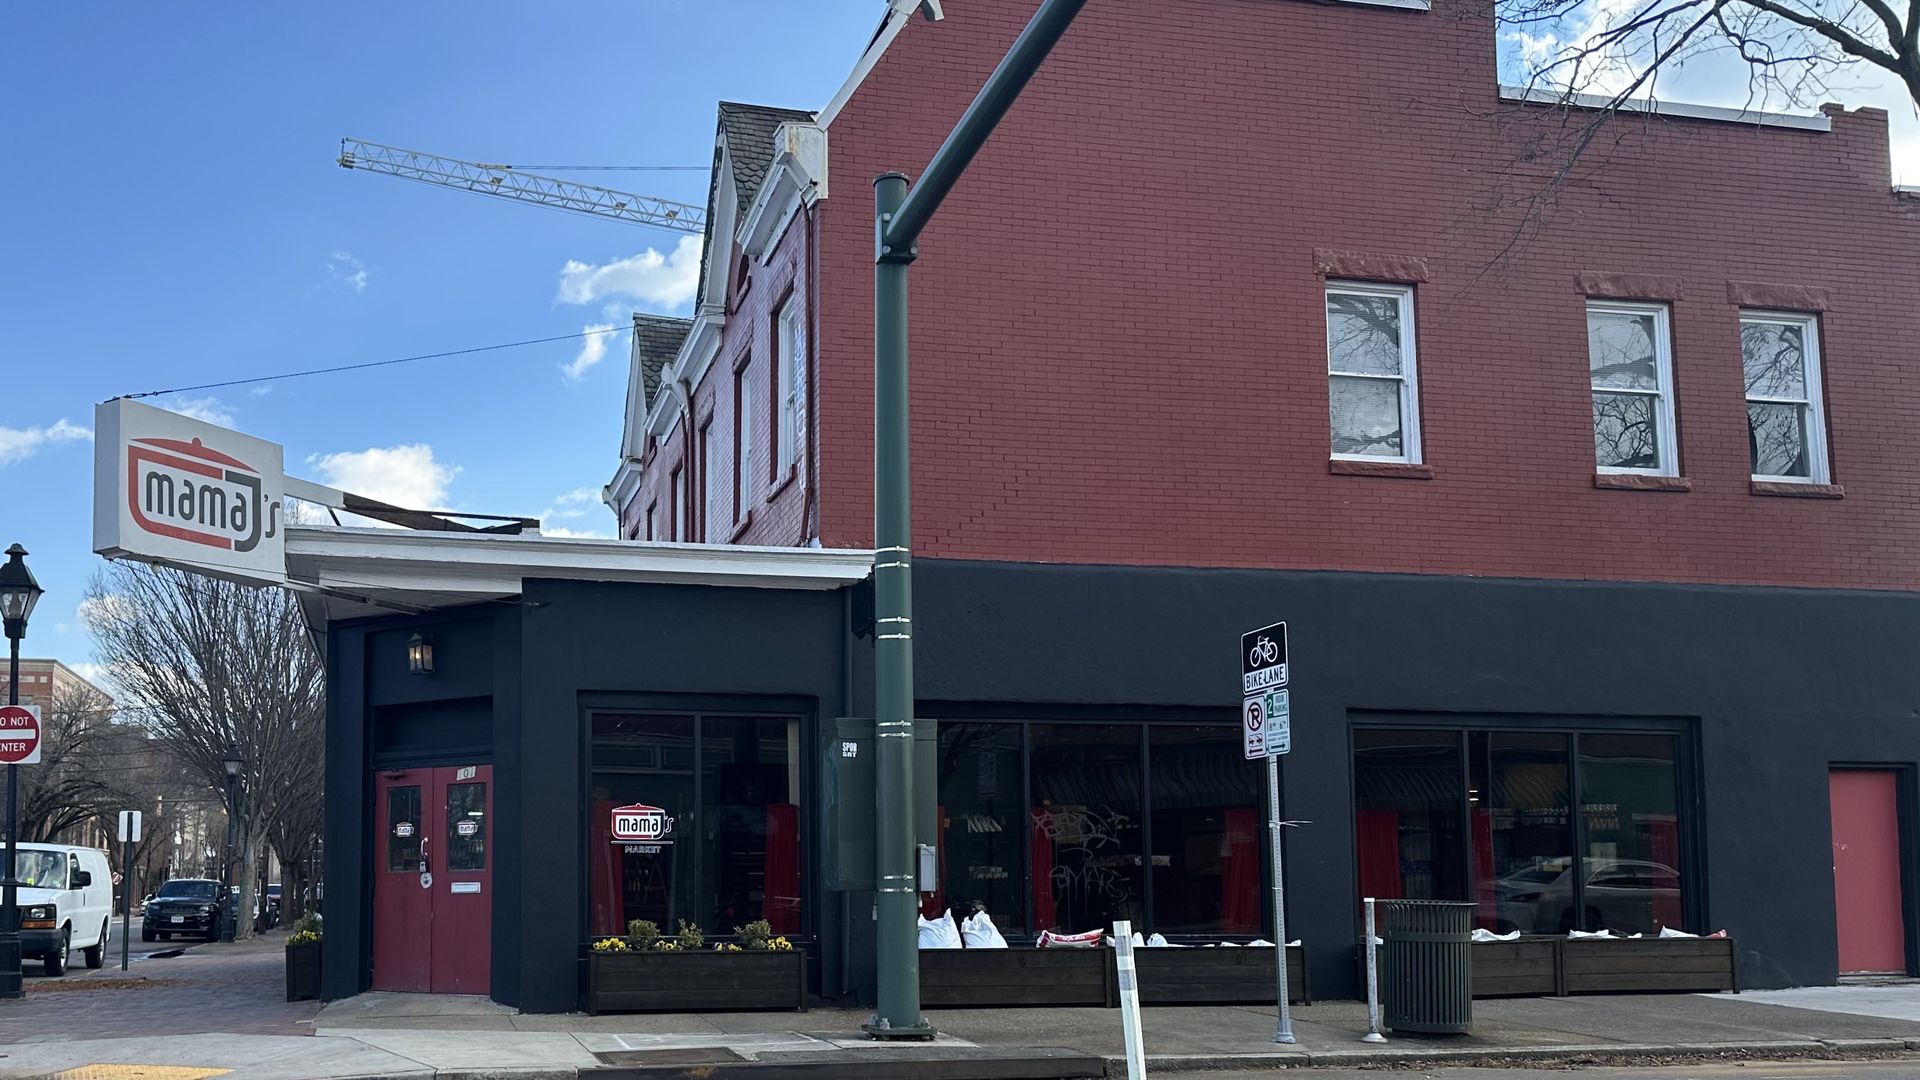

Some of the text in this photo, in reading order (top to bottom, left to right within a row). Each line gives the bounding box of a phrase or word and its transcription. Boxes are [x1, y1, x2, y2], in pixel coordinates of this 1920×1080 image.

[1246, 666, 1284, 689] BIKE LANE
[1268, 699, 1273, 714] 2
[0, 716, 29, 727] O NOT
[624, 845, 661, 854] MARKET
